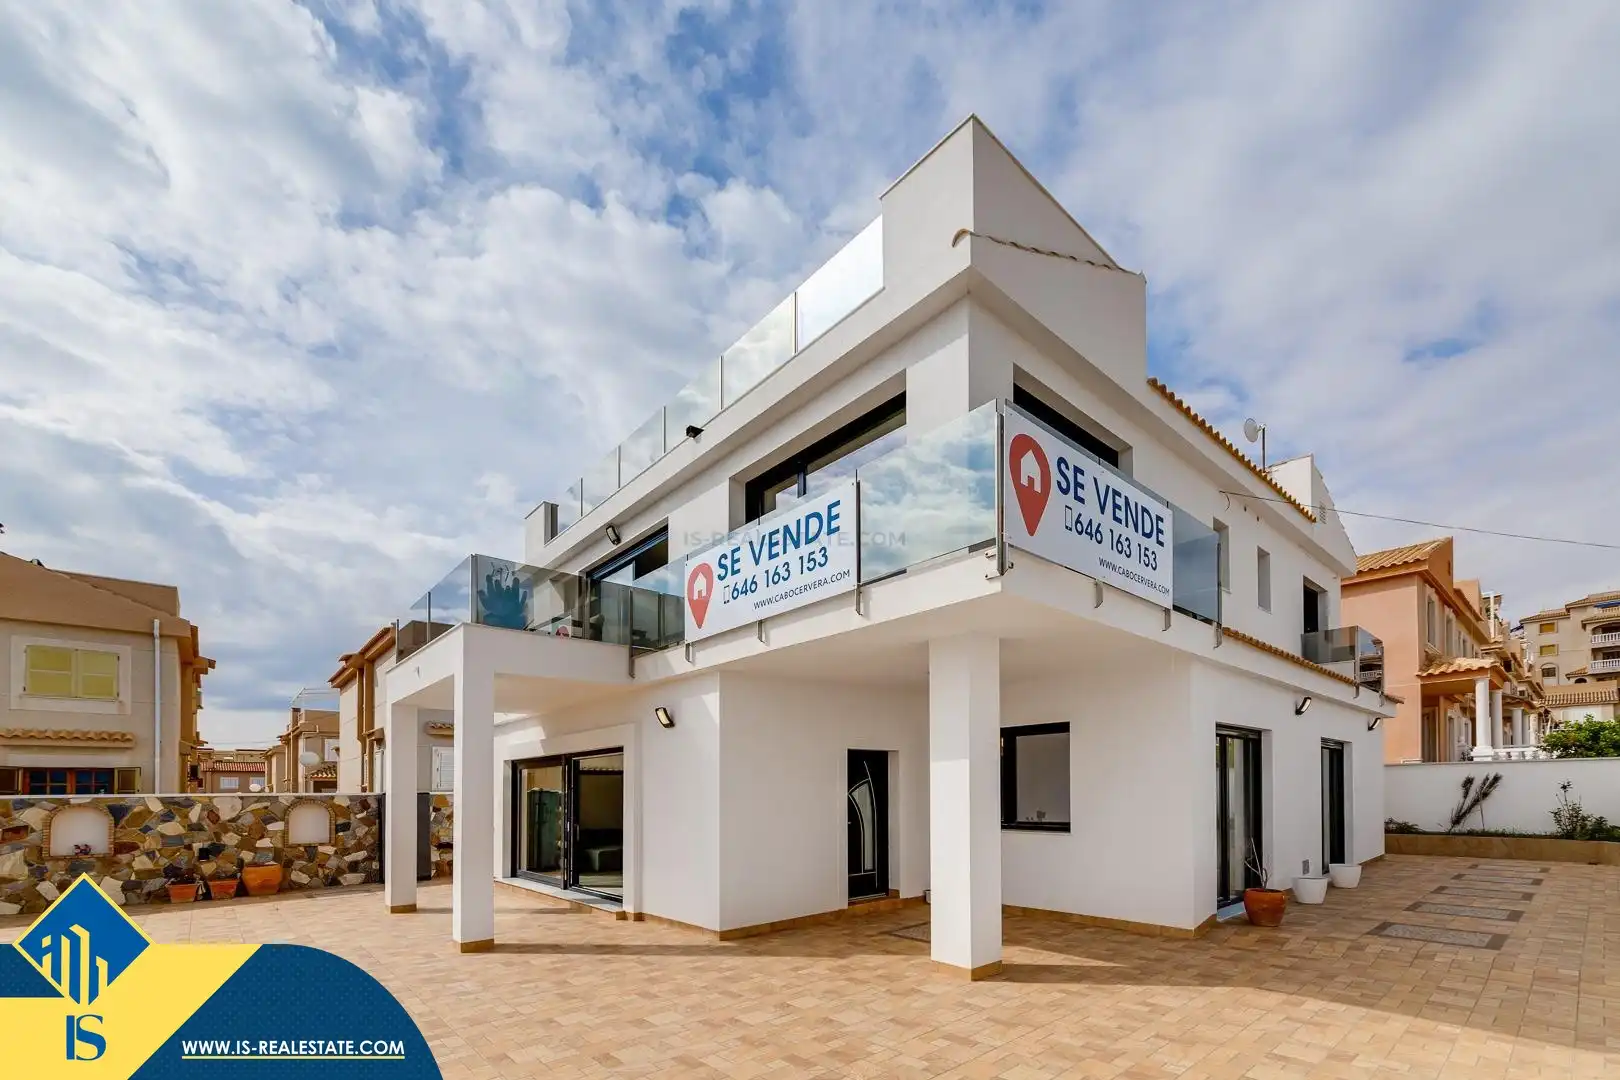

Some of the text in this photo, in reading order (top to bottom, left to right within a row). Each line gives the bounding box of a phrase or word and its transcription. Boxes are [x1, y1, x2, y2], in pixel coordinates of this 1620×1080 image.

[1056, 456, 1165, 548] SE VENDE
[717, 500, 841, 581] SE VENDE
[1074, 512, 1158, 571] 646 163 153
[731, 546, 829, 601] 646 163 153
[753, 569, 851, 611] WWW.CABOCERVERA.COM
[1099, 556, 1170, 596] WWW.CABOCERVERA.COM
